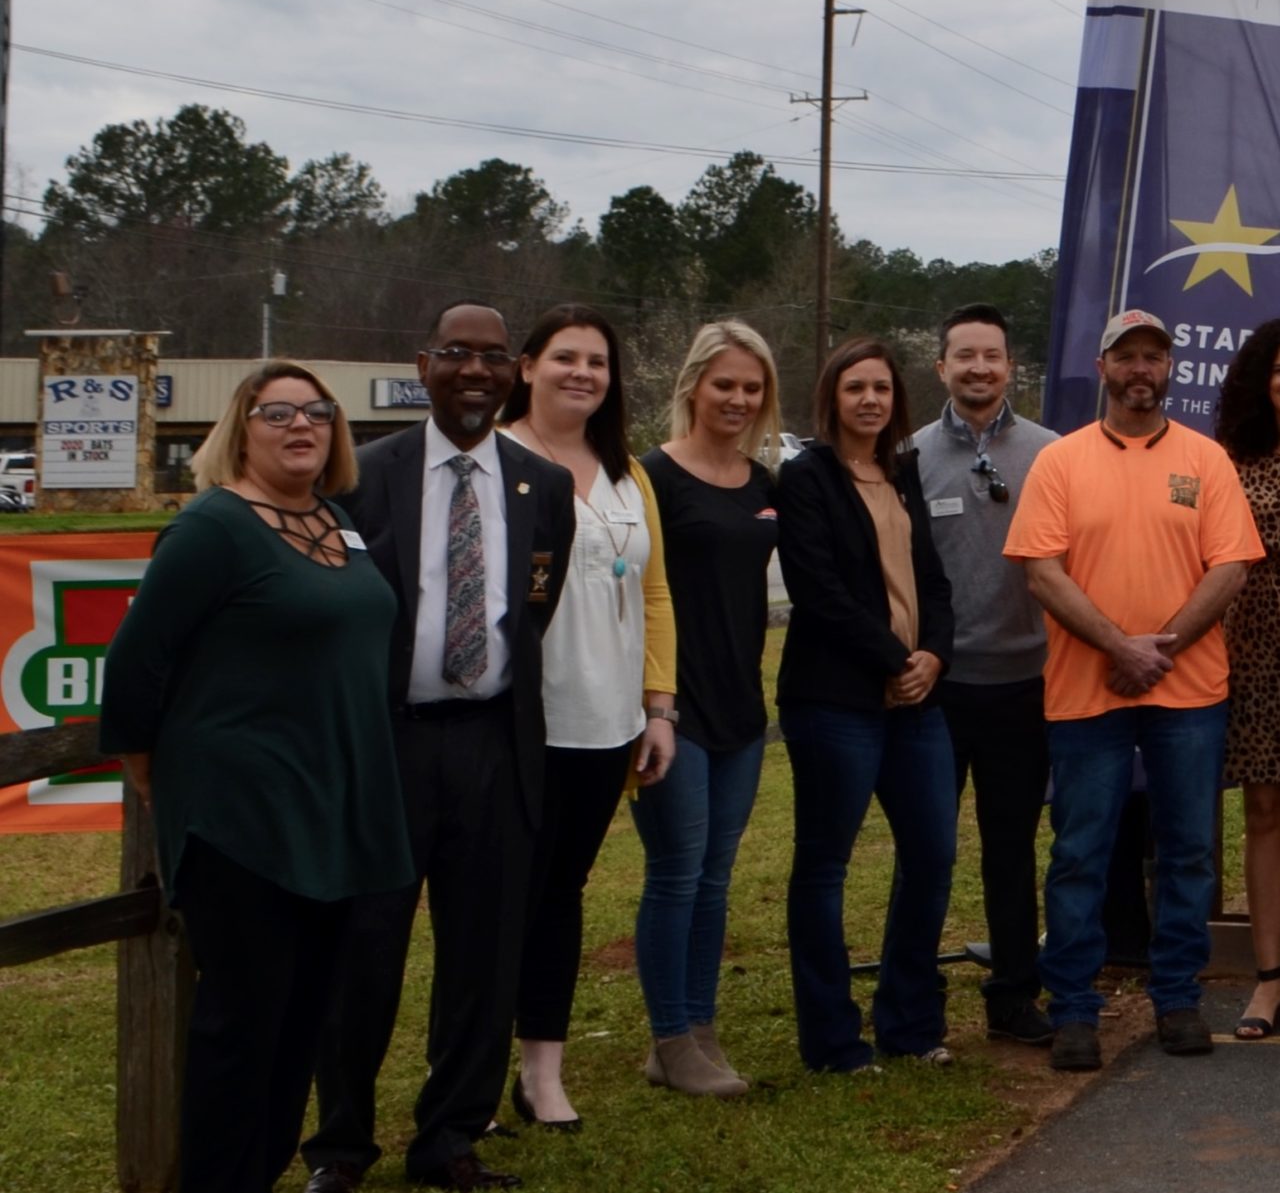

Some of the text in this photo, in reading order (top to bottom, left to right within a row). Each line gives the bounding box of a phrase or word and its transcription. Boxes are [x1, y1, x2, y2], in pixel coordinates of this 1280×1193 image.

[47, 378, 134, 404] R & S
[1181, 398, 1211, 415] THE
[46, 421, 135, 435] SPORTS
[91, 440, 113, 450] BATS
[82, 451, 109, 461] STOCK
